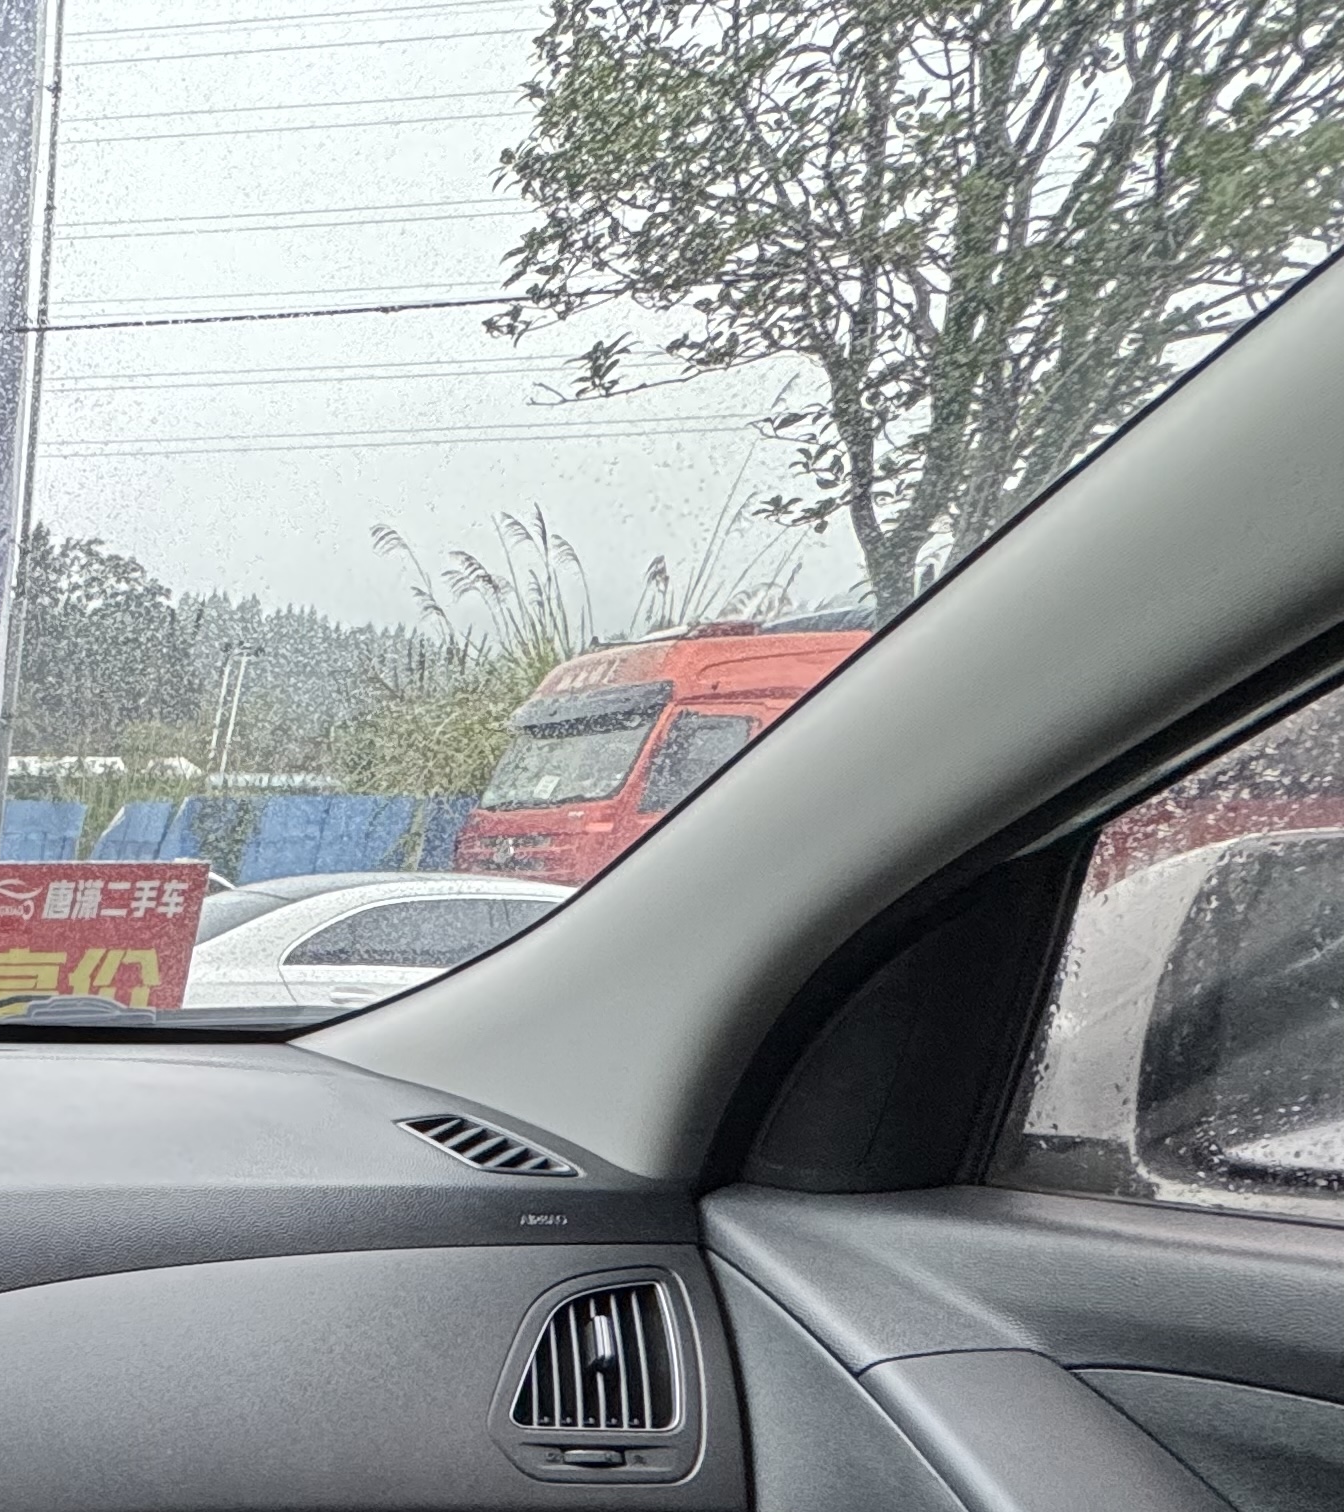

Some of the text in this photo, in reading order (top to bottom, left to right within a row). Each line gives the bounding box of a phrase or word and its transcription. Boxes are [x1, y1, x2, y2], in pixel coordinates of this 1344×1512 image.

[42, 879, 189, 920] 唐潇二手车
